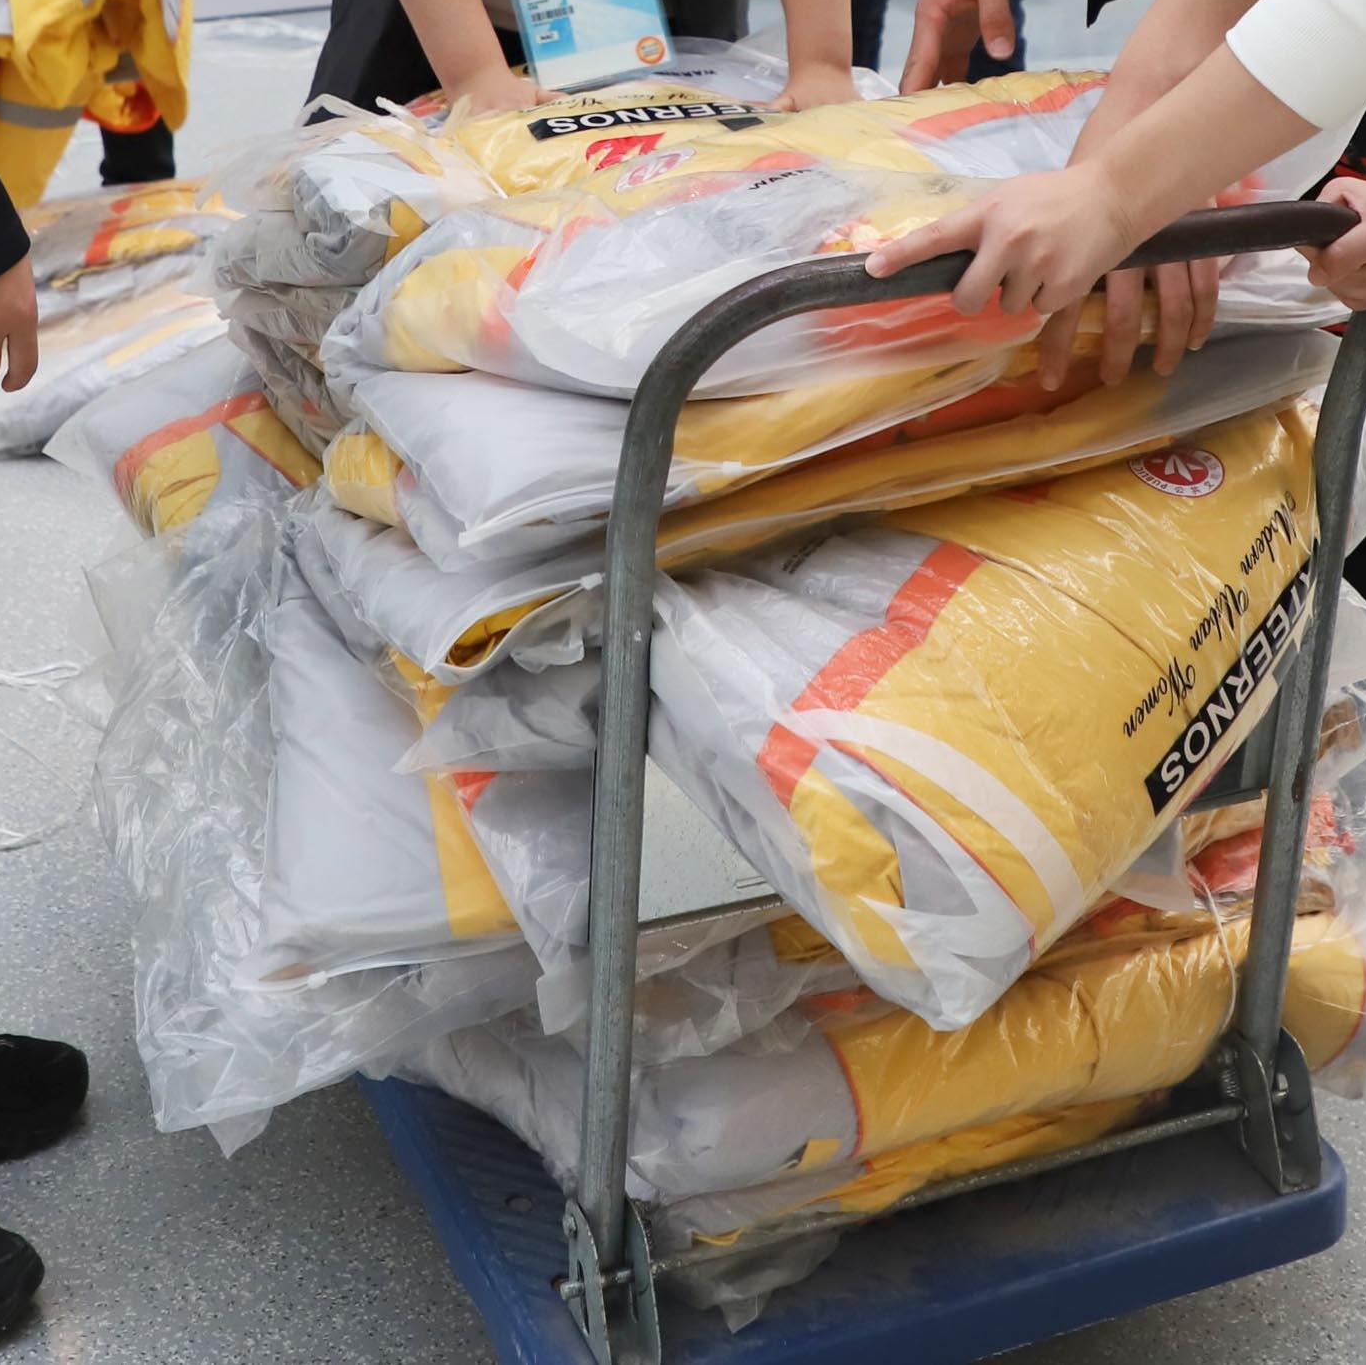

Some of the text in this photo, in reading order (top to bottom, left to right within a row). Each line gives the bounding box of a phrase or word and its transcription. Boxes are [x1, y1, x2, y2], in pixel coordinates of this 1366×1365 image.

[1123, 490, 1297, 739] Modern Urban Women
